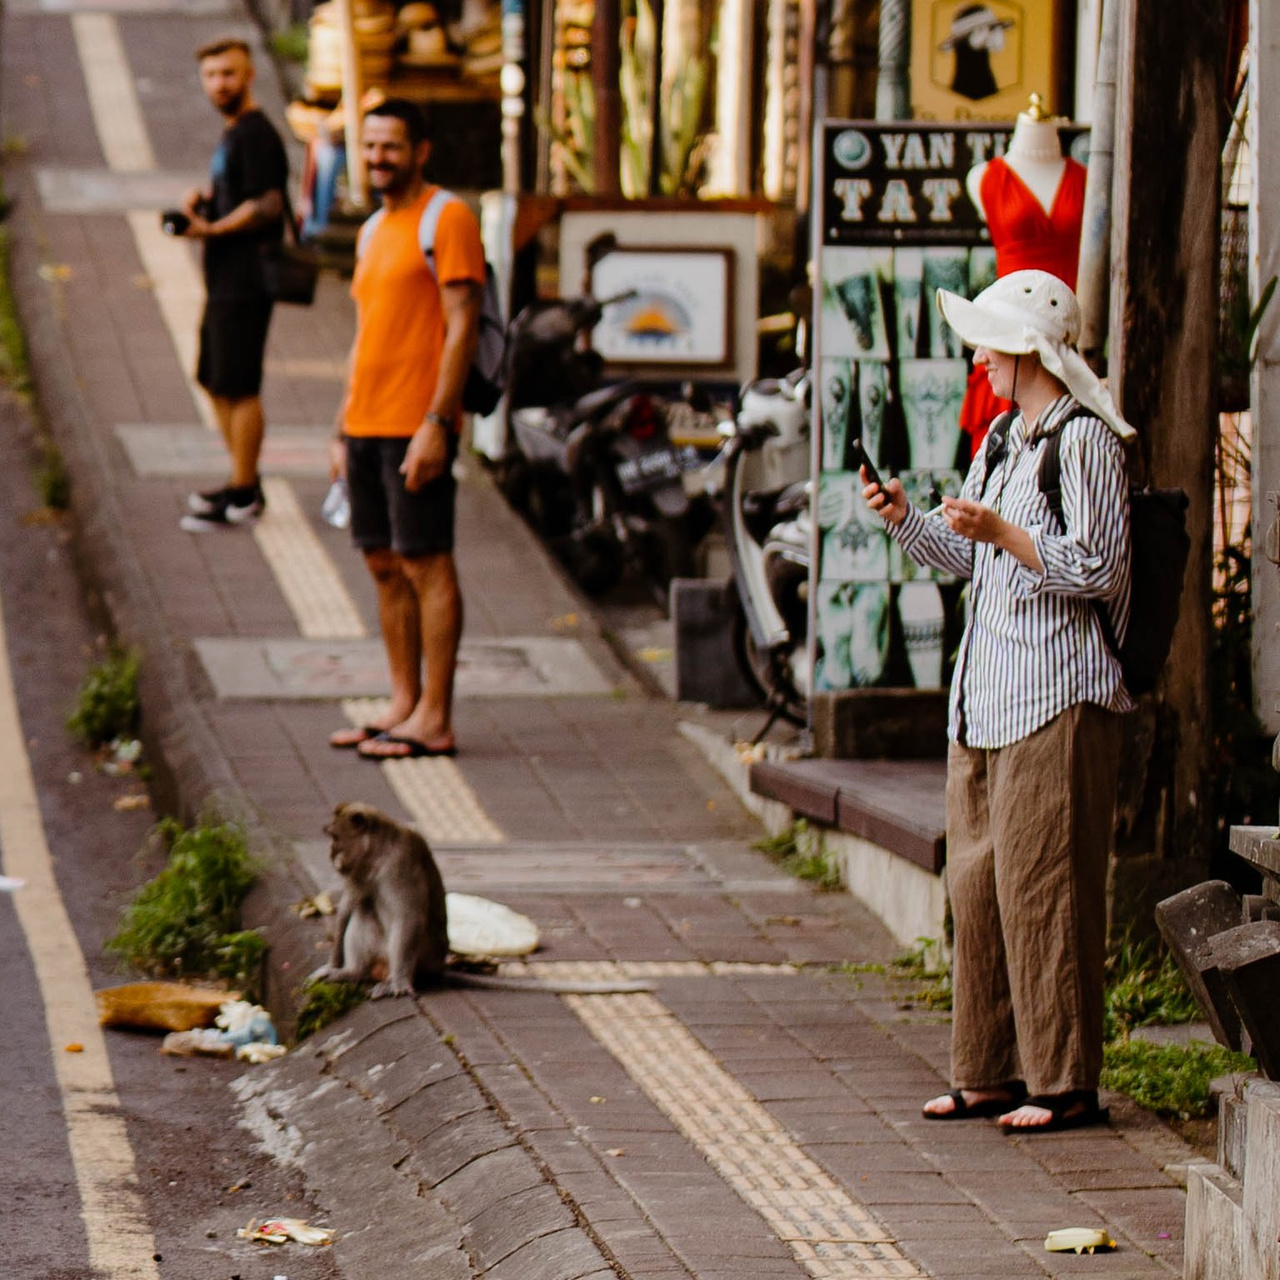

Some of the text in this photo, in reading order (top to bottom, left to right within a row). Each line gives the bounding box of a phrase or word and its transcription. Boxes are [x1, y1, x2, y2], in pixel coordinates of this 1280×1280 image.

[880, 132, 1012, 168] YAN TI
[833, 178, 986, 221] TAT
